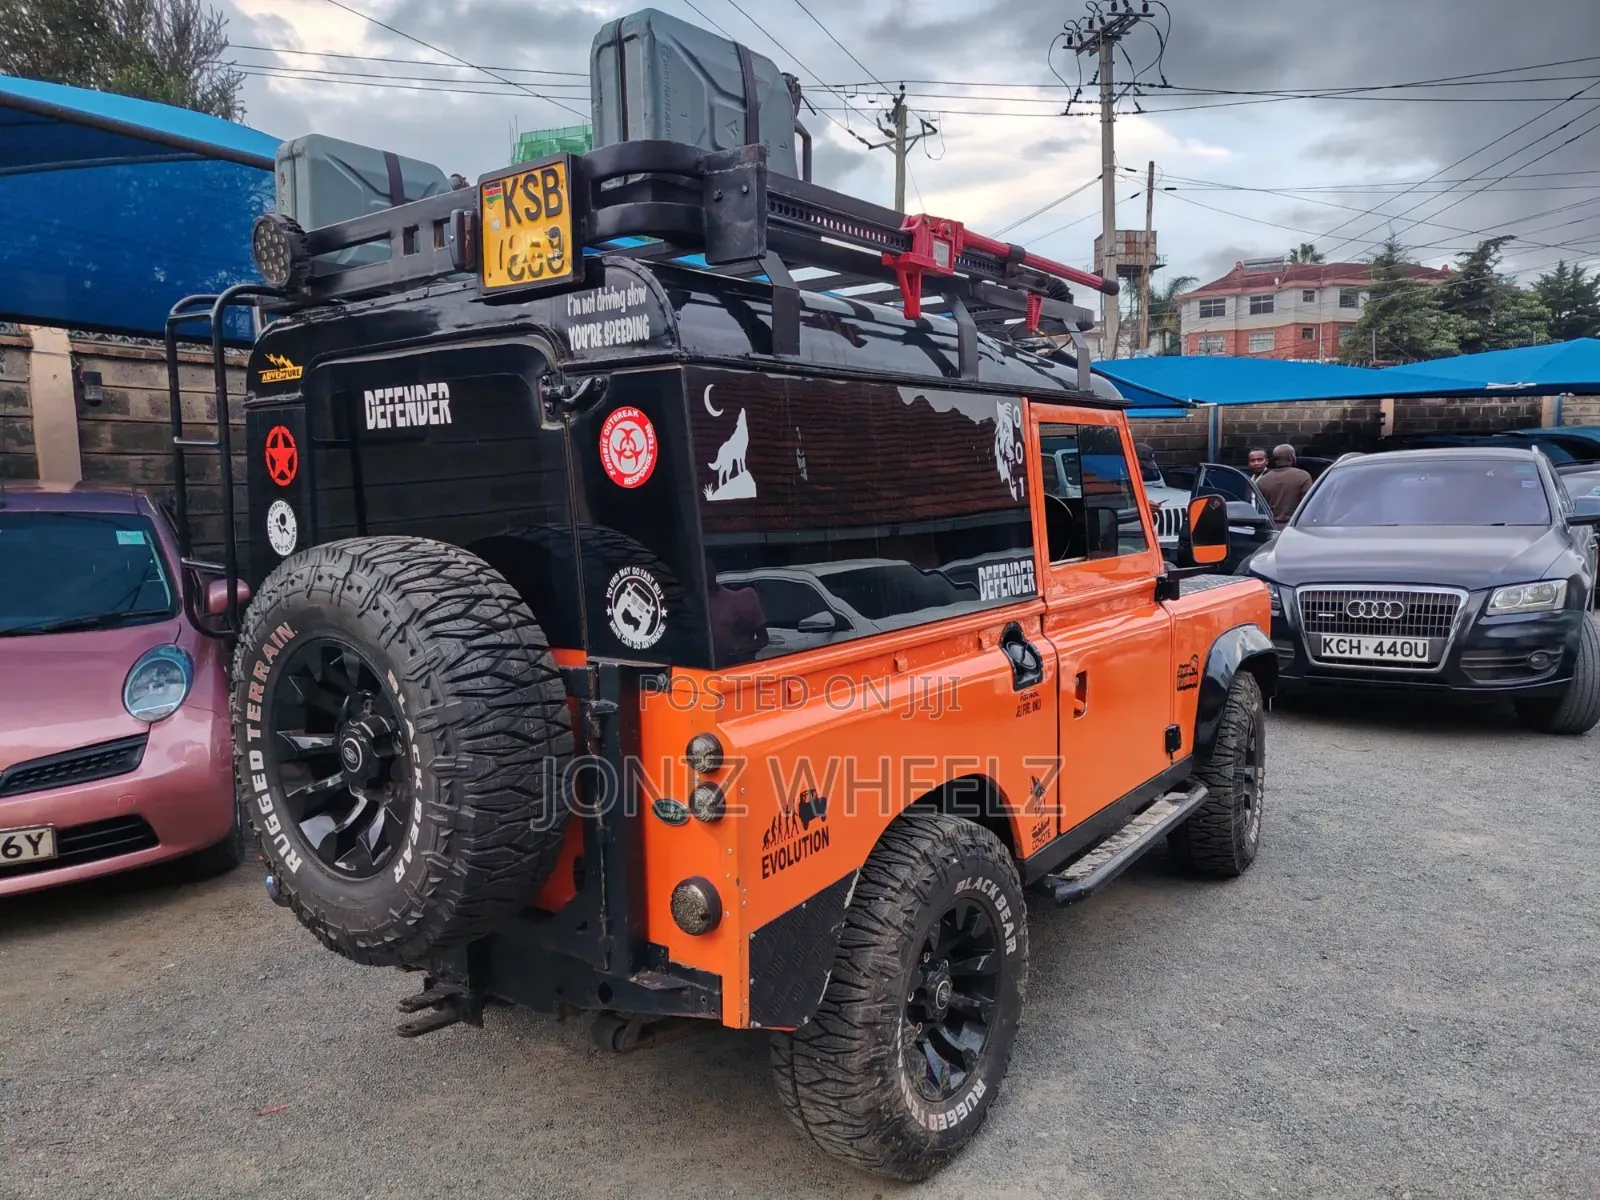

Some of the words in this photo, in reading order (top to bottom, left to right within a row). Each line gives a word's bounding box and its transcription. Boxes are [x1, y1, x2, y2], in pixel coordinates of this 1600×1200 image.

[502, 168, 563, 228] KSB
[582, 291, 595, 314] not
[597, 285, 626, 313] driving
[627, 281, 647, 306] slow
[568, 322, 602, 351] YOU'RE
[604, 313, 650, 346] SPEEDING
[262, 369, 301, 381] ADVENTURE
[364, 382, 452, 430] DEFENDER
[604, 410, 640, 436] OUTBREAK
[602, 438, 616, 476] ZOMBIE
[624, 453, 653, 485] RESPONSE
[606, 573, 620, 598] YOURS
[619, 566, 631, 578] MAY
[632, 567, 640, 575] GO
[640, 569, 655, 584] FAST
[653, 582, 665, 600] BUT
[978, 559, 1036, 602] DEFENDER
[608, 620, 622, 640] MINE
[621, 635, 632, 648] CAN
[632, 640, 641, 650] GO
[641, 621, 667, 650] ANYWHERE
[1322, 637, 1361, 655] KCH
[1373, 640, 1428, 658] 440U
[246, 621, 297, 742] TERRAIN
[249, 750, 303, 874] RUGGED
[761, 826, 830, 880] EVOLUTION
[928, 1078, 987, 1131] RUGGED
